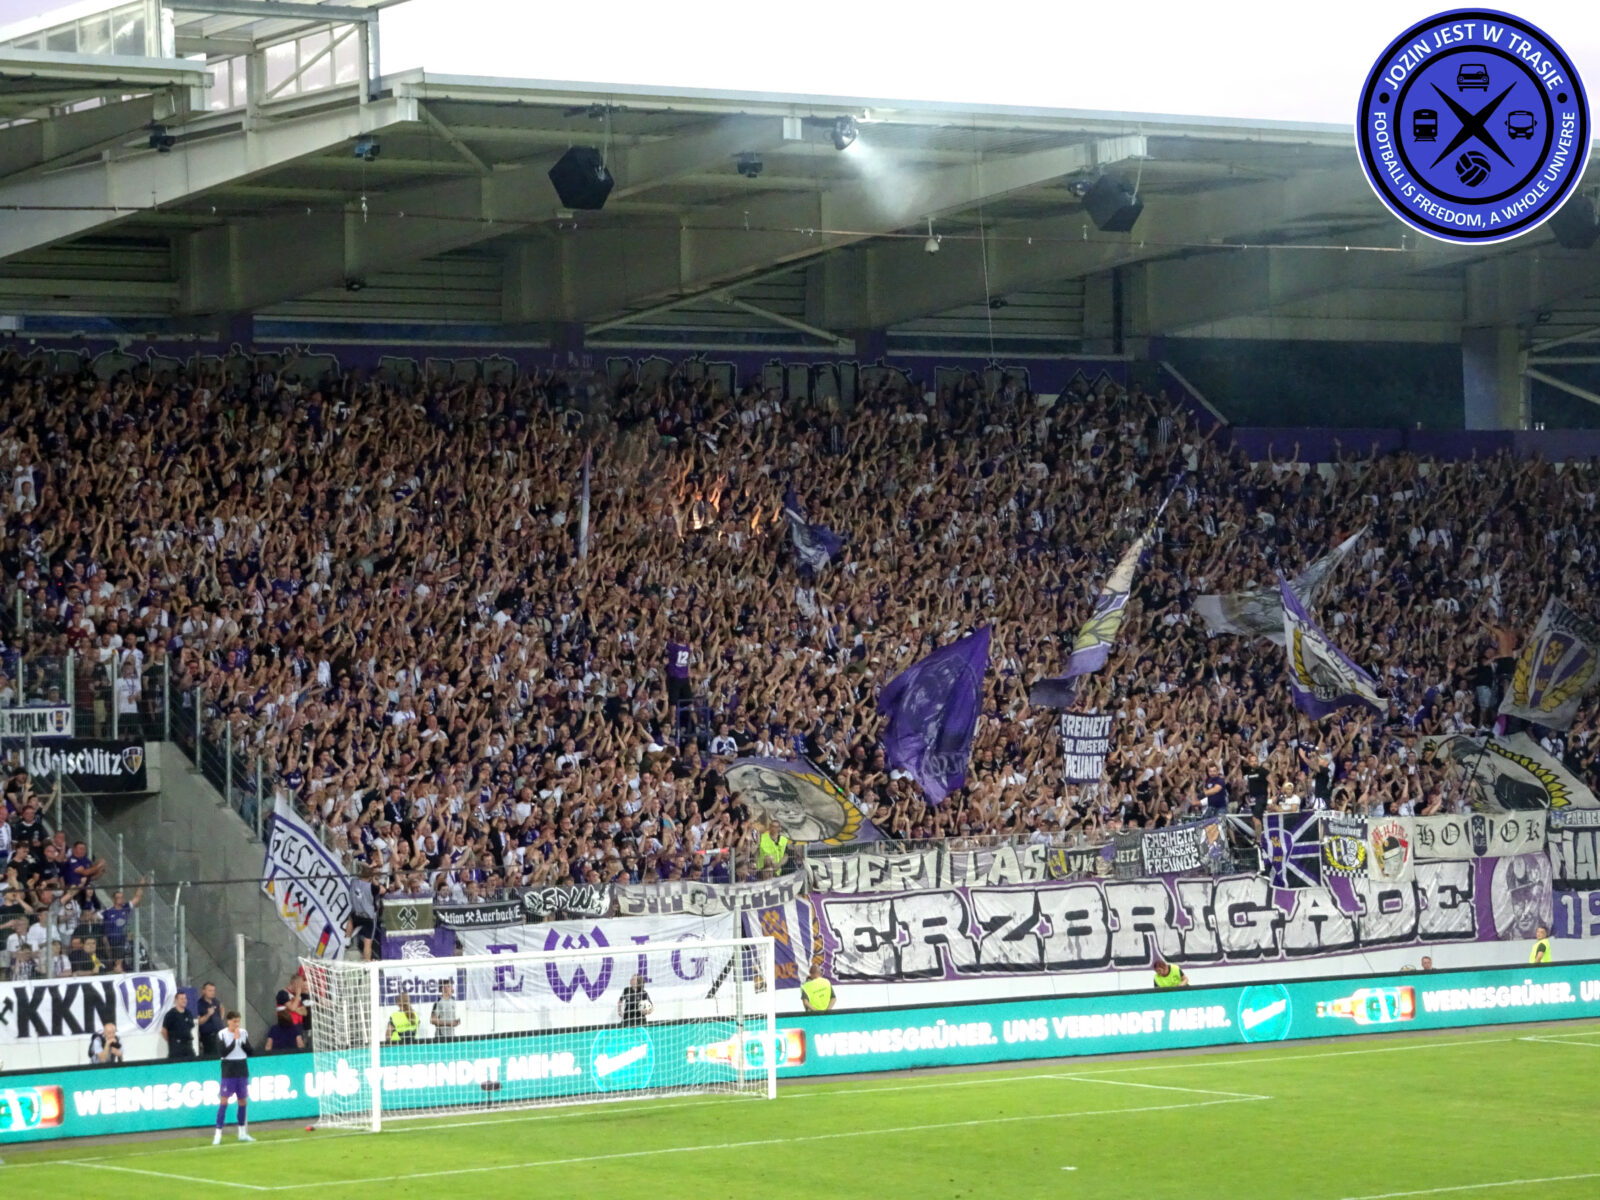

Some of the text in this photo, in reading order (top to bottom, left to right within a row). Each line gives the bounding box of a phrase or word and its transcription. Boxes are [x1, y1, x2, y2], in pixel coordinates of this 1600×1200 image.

[677, 651, 689, 664] 12
[1061, 713, 1112, 737] FREIHEIT
[1144, 827, 1196, 848] FREIHEIT
[1147, 852, 1201, 874] FREUNDE
[823, 859, 1478, 981] ERZBRIGADE
[13, 980, 117, 1038] KKN
[1422, 979, 1576, 1012] WERNESGRÜNER.
[814, 1019, 998, 1057] WERNESGRÜNER.
[1003, 1018, 1049, 1044] UNS
[1052, 1011, 1166, 1040] VERBINDET
[1169, 1005, 1232, 1030] MEHR.
[73, 1074, 298, 1117] WERNESGRNER.
[364, 1057, 501, 1091] VERBINDET
[506, 1052, 581, 1081] MEHR.
